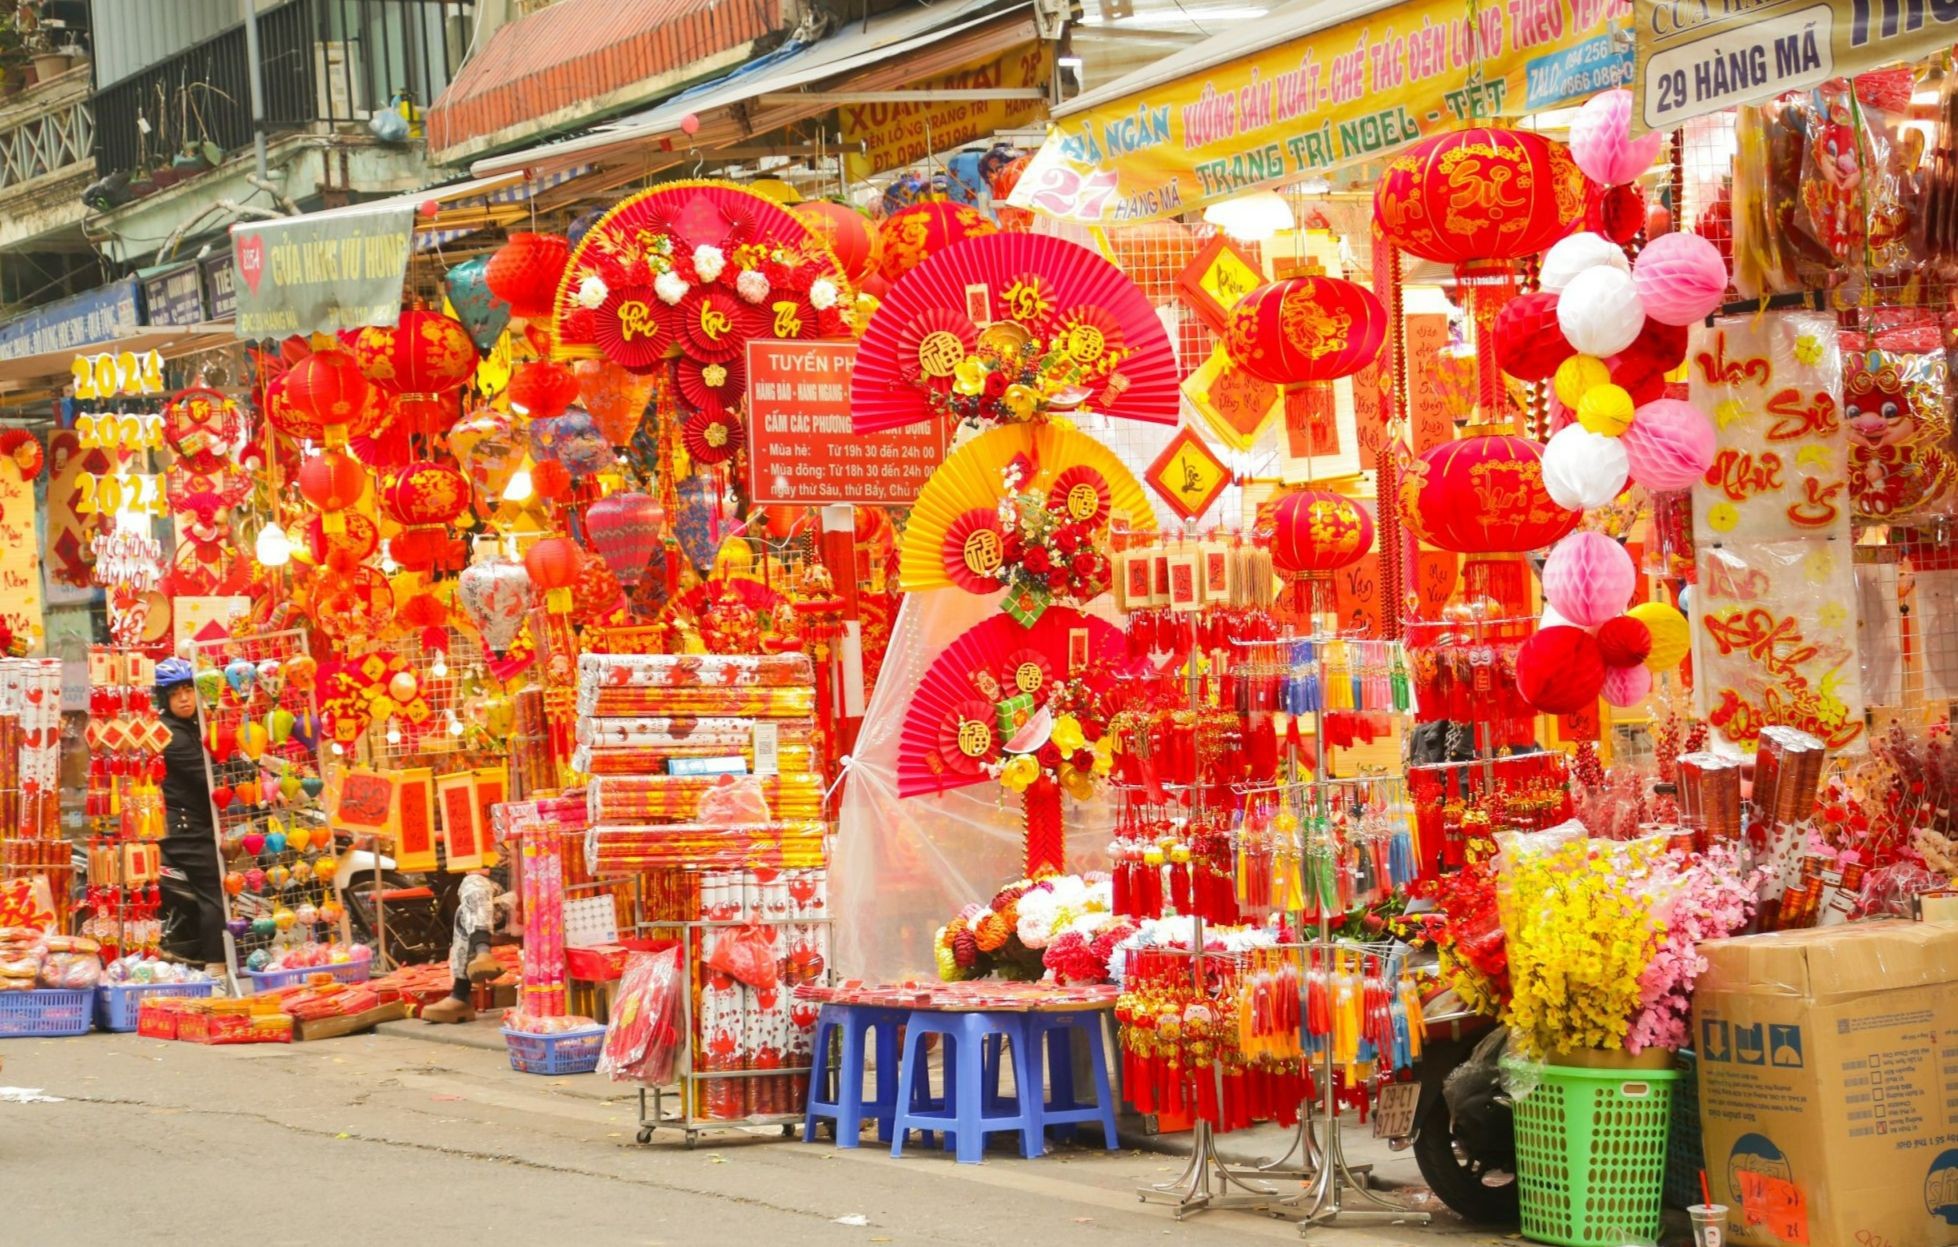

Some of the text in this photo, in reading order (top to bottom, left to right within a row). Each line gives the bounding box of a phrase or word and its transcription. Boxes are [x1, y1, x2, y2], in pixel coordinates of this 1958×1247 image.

[1584, 40, 1608, 63] 256
[1656, 69, 1687, 112] 29
[1695, 49, 1767, 102] HÀNG
[1774, 21, 1821, 80] MÃ
[1181, 80, 1235, 150] XƯỞNG
[1239, 67, 1272, 133] SẢN
[1371, 28, 1404, 93] TÁC
[1408, 17, 1449, 82] ĐÈN
[1509, 0, 1563, 52] THEO
[1104, 103, 1171, 157] NGÂN
[1196, 143, 1285, 199] TRANG
[1287, 120, 1335, 171] TRÍ
[1339, 106, 1421, 159] NOEL
[1443, 69, 1508, 120] TẾT
[1032, 166, 1119, 220] 27
[1114, 179, 1183, 219] HÀNG MÃ
[271, 231, 303, 287] CỬA
[768, 349, 829, 372] TUYẾN
[919, 331, 964, 377] 福
[1069, 325, 1105, 361] 福
[70, 349, 165, 400] 2024
[764, 409, 788, 433] CẤM
[790, 411, 811, 433] CÁC
[812, 414, 852, 435] PHƯƠNG
[769, 444, 792, 456] Mùa
[795, 443, 811, 457] hè:
[828, 444, 842, 457] Từ
[844, 443, 862, 457] 19h
[865, 444, 877, 457] 30
[880, 442, 899, 458] đến
[901, 444, 920, 457] 24h
[923, 445, 935, 457] 00
[770, 463, 792, 477] Mùa
[795, 463, 826, 479] đông:
[828, 463, 843, 477] Từ
[845, 464, 863, 477] 18h
[866, 464, 879, 477] 30
[881, 463, 900, 478] đến
[902, 464, 921, 478] 24h
[818, 482, 842, 498] Sáu,
[844, 482, 862, 497] thứ
[864, 481, 887, 499] Bảy,
[889, 482, 910, 497] Chủ
